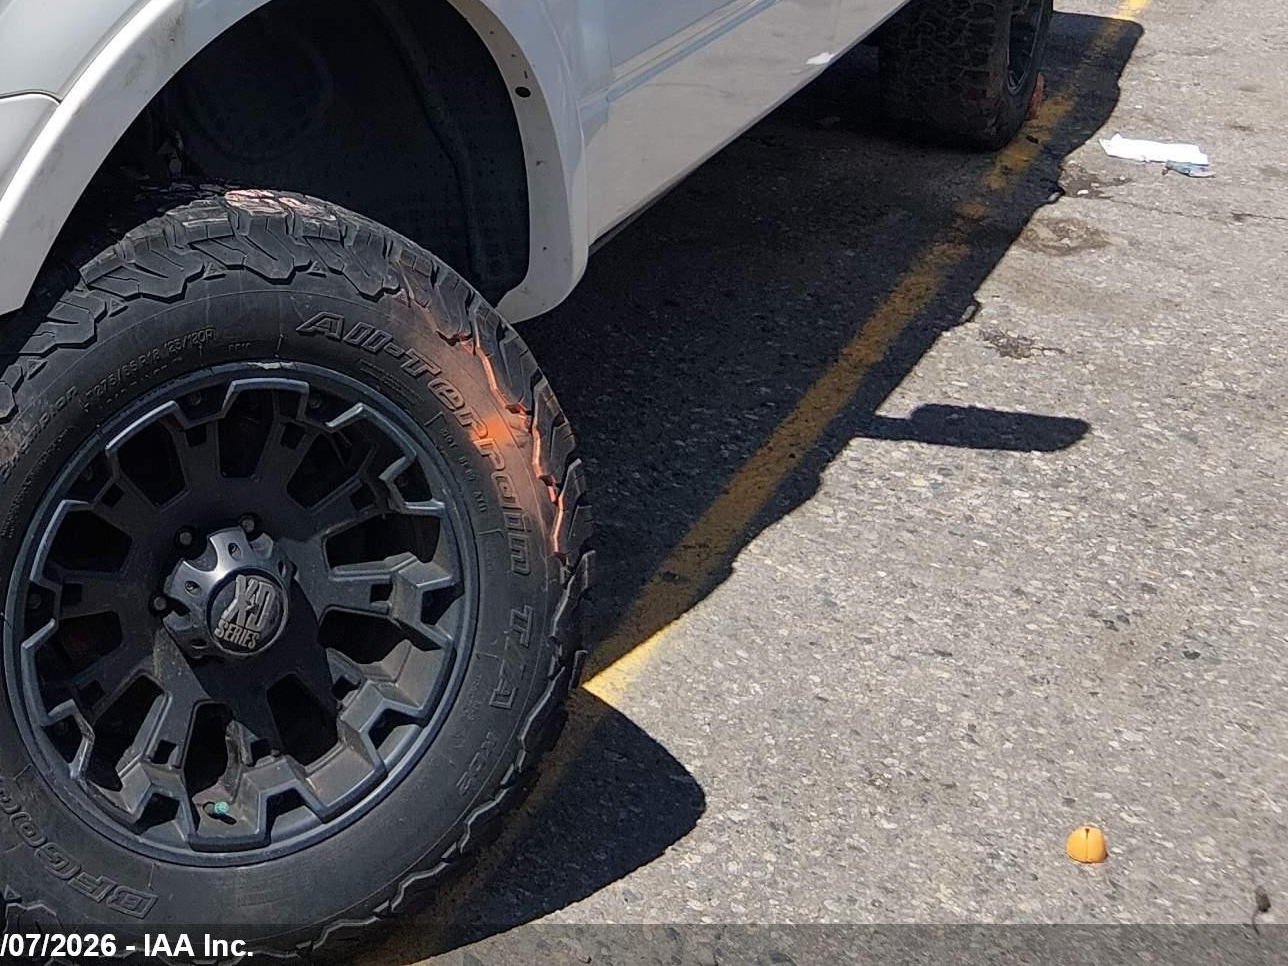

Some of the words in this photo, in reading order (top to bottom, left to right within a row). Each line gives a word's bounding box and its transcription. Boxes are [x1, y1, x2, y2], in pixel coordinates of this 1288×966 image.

[296, 311, 532, 577] All-Terrain
[220, 574, 276, 633] XD
[214, 619, 260, 650] SERIES
